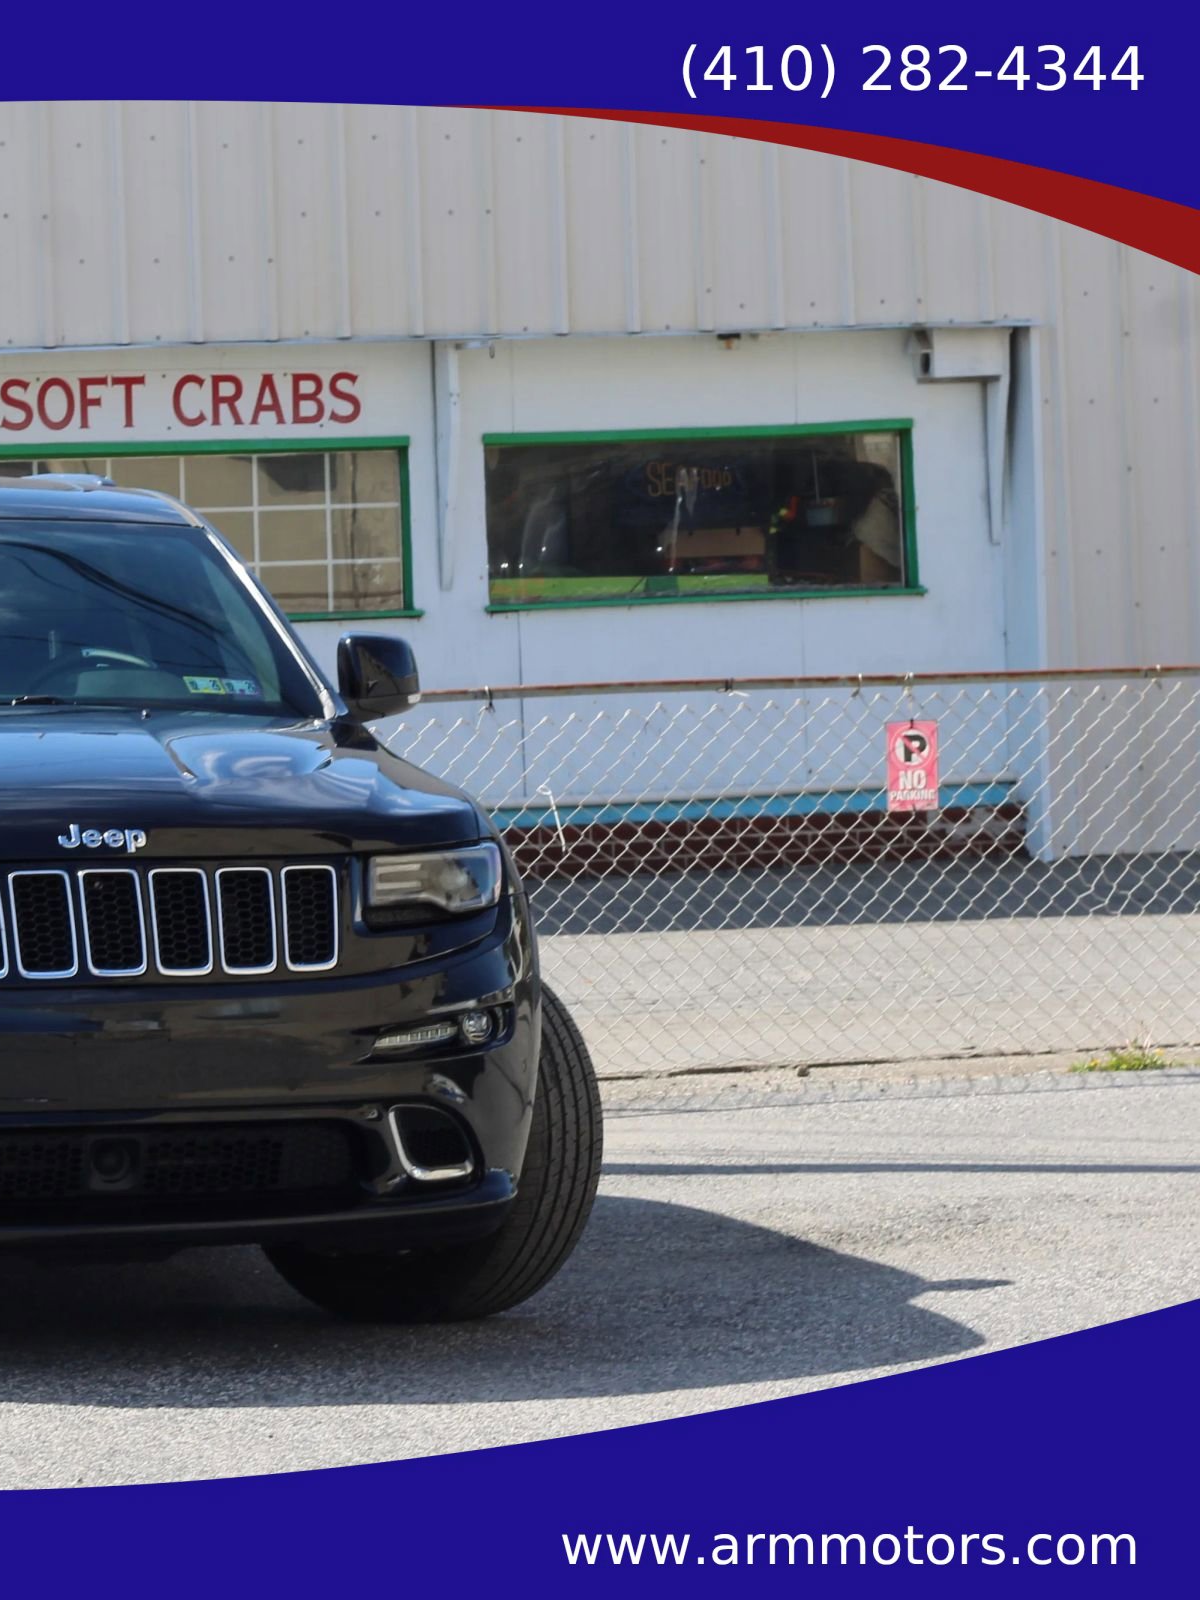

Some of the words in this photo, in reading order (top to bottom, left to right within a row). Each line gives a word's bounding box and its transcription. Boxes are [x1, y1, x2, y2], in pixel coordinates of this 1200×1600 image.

[0, 374, 146, 431] SOFT
[172, 371, 362, 427] CRABS
[899, 769, 927, 790] NO
[890, 789, 936, 801] PARKING
[58, 823, 147, 853] Jeep
